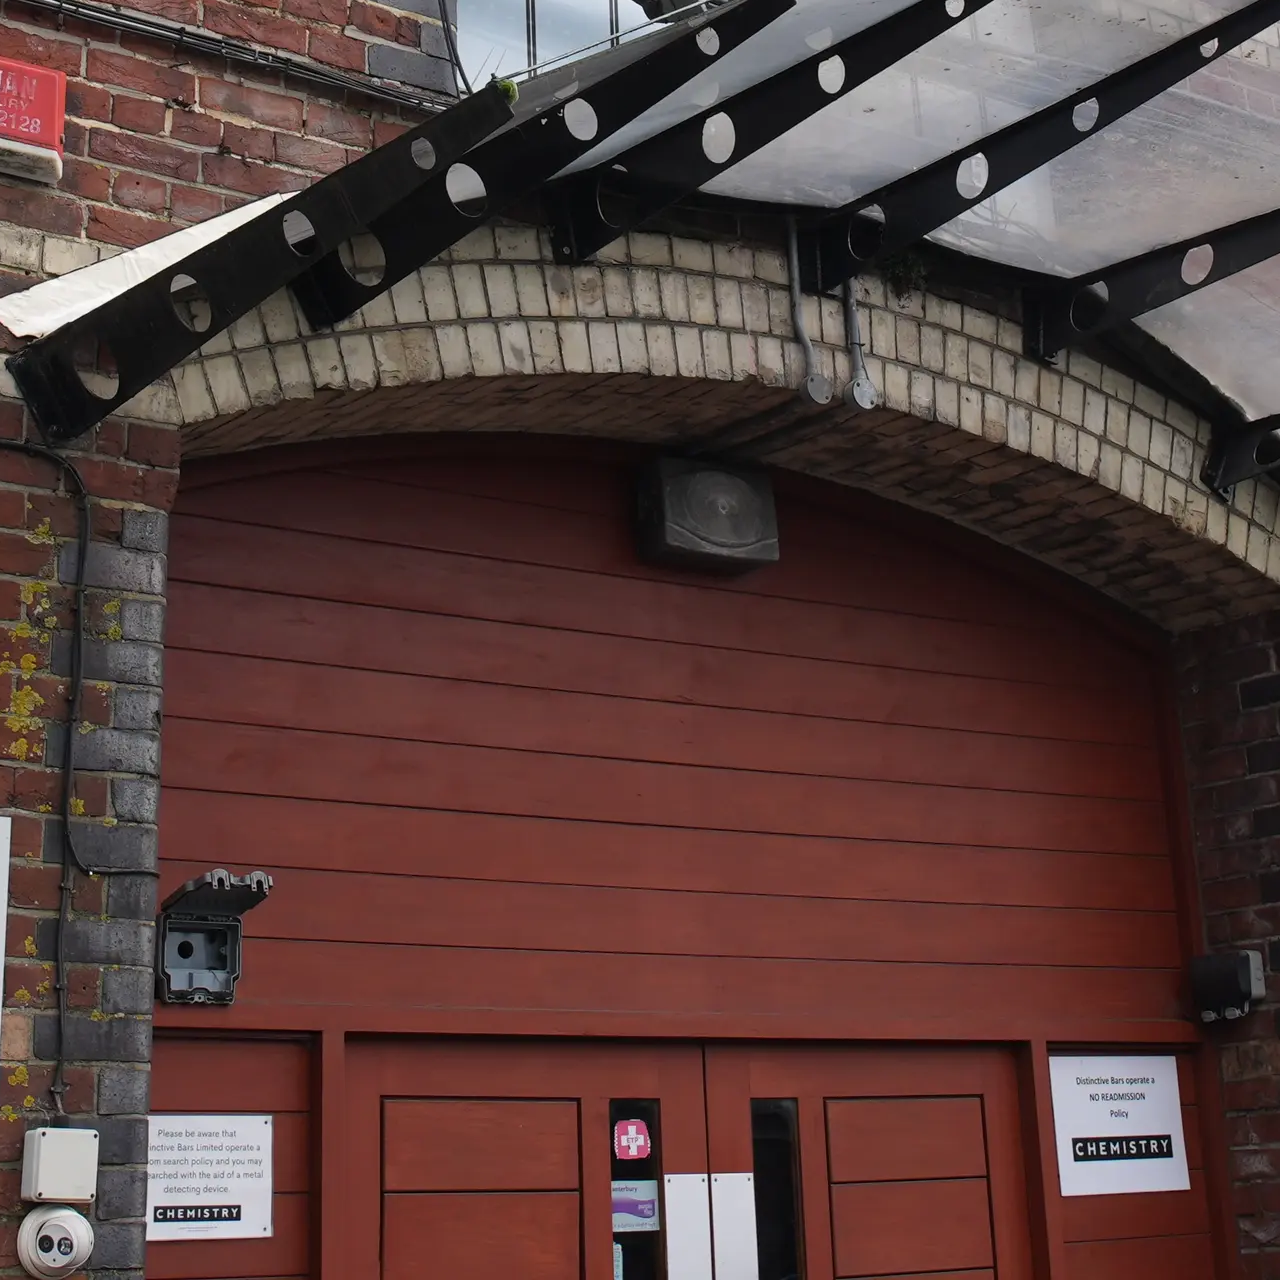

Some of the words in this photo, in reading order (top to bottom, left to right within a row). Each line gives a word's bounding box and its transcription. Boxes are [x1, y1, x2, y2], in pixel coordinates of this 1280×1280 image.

[1075, 1076, 1109, 1085] Distinctive
[1111, 1076, 1124, 1084] Bars
[1126, 1076, 1150, 1085] operate
[1089, 1093, 1099, 1101] NO
[1101, 1092, 1146, 1101] READMISSION
[1110, 1109, 1129, 1119] Policy
[157, 1129, 183, 1138] Please
[185, 1129, 195, 1138] be
[222, 1129, 237, 1138] that
[148, 1142, 175, 1152] inctive
[177, 1143, 194, 1151] Bars
[196, 1143, 223, 1152] Limited
[225, 1144, 254, 1154] operate
[1075, 1140, 1168, 1156] CHEMISTRY
[163, 1157, 188, 1166] search
[191, 1157, 213, 1167] policy
[215, 1157, 230, 1166] and
[232, 1159, 245, 1167] you
[247, 1159, 263, 1167] may
[147, 1171, 178, 1180] earched
[180, 1171, 197, 1180] with
[199, 1171, 210, 1179] the
[213, 1170, 225, 1179] aid
[226, 1170, 234, 1179] of
[242, 1170, 264, 1178] metal
[163, 1184, 201, 1195] detecting
[203, 1184, 231, 1194] device.
[156, 1207, 239, 1219] CHEMISTRY
